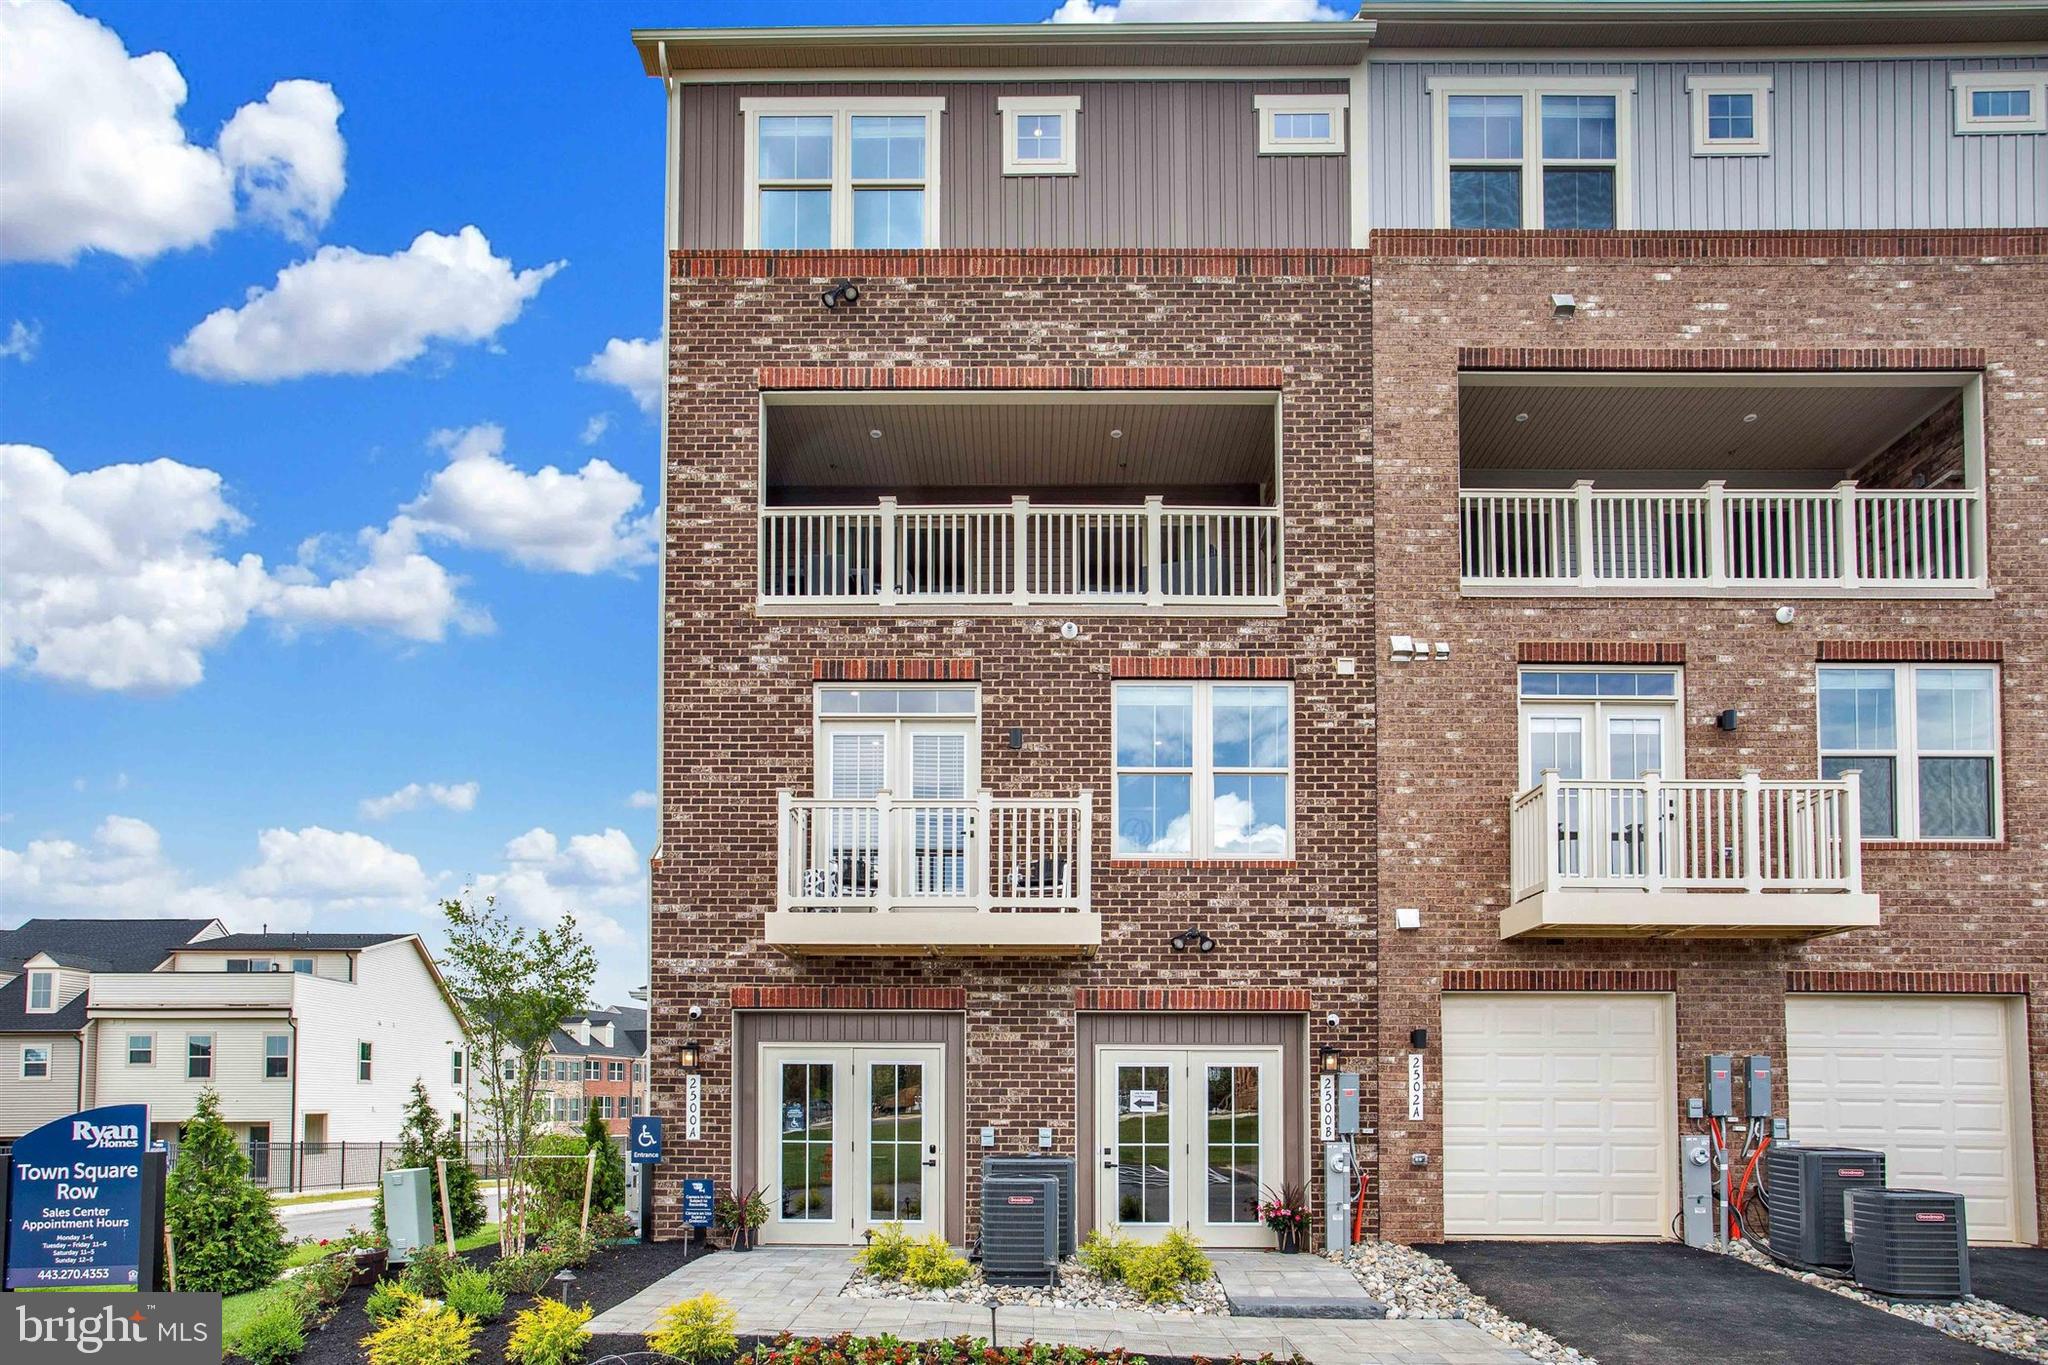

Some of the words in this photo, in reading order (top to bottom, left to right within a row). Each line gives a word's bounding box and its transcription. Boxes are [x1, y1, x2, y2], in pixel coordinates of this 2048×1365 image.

[689, 1078, 697, 1138] 2500A
[1324, 1078, 1332, 1137] 2500B
[72, 1121, 138, 1148] Ryan
[100, 1140, 138, 1148] Homes
[17, 1164, 69, 1180] Town
[74, 1162, 138, 1182] Square
[57, 1183, 98, 1200] Row
[42, 1208, 71, 1218] Sales
[73, 1207, 110, 1217] Center
[21, 1219, 94, 1231] Appointment
[96, 1218, 129, 1227] Hours
[37, 1268, 110, 1280] 443.270.4353
